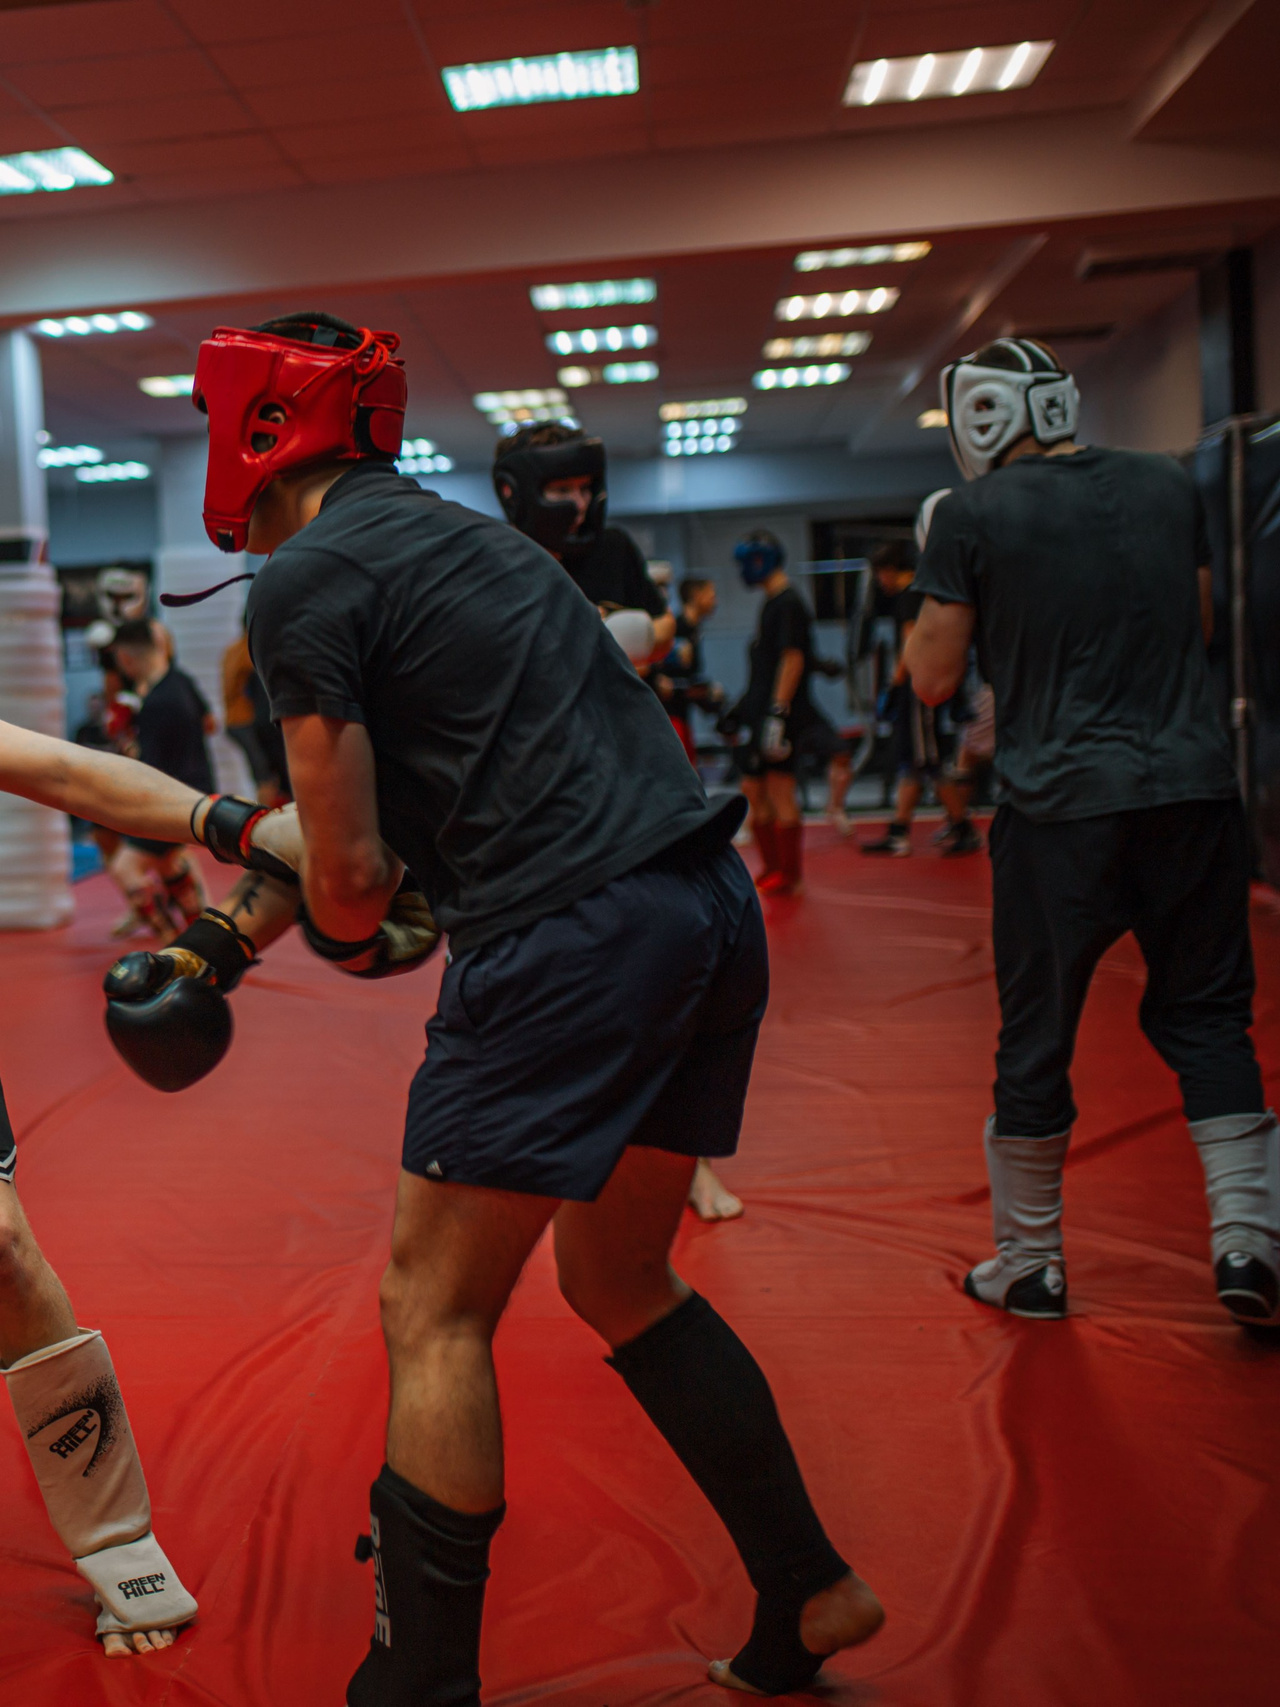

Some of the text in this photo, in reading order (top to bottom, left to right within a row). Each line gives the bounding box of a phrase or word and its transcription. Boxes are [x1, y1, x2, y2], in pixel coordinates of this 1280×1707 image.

[49, 1410, 94, 1453] GREEN
[56, 1423, 98, 1459] HILL
[117, 1572, 166, 1591] GREEN
[123, 1583, 165, 1600] HILL
